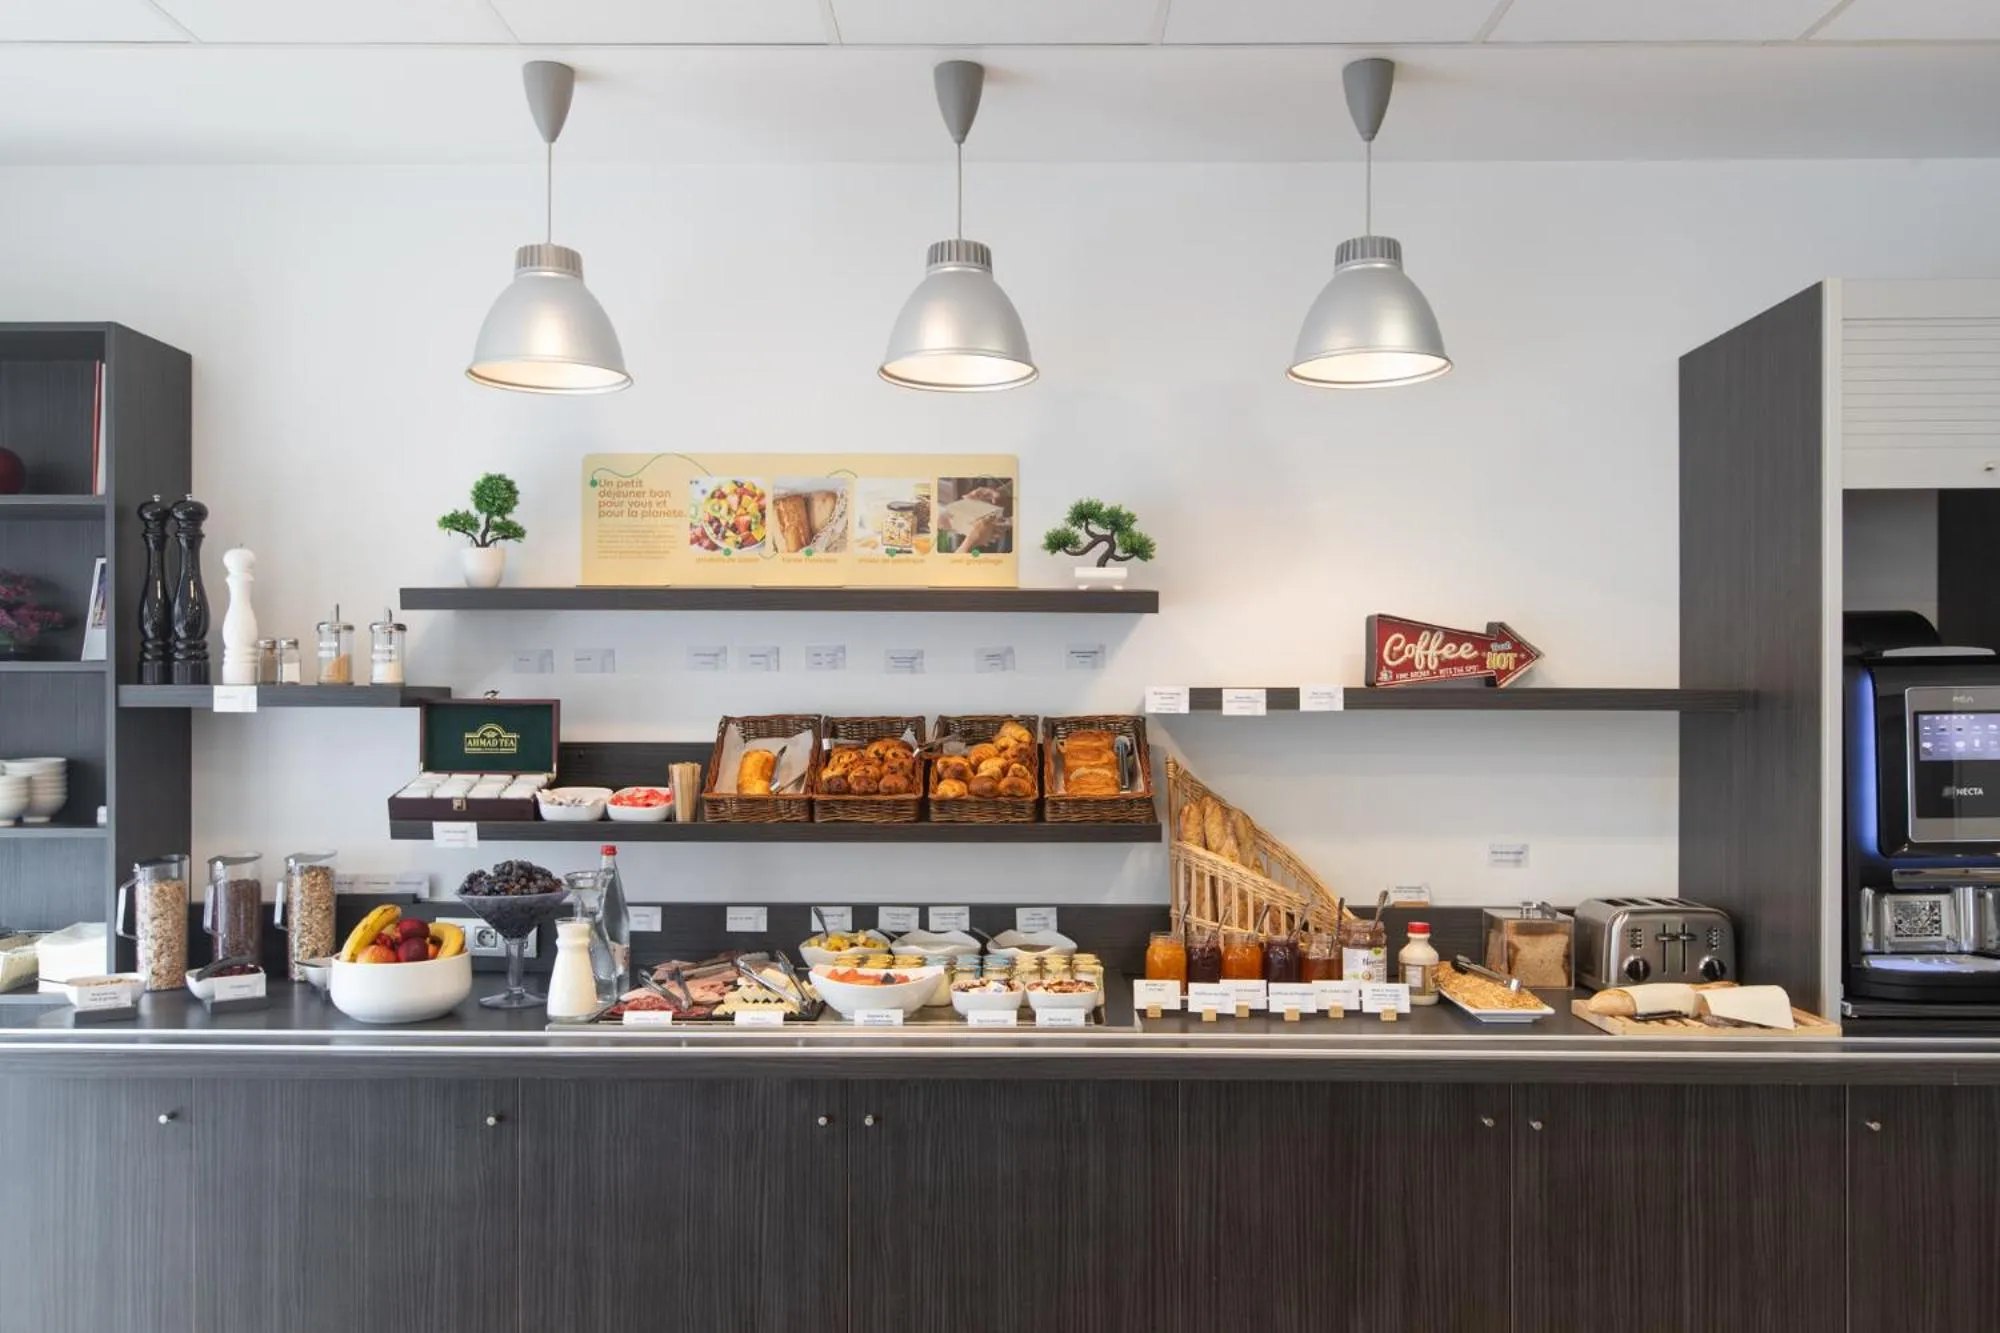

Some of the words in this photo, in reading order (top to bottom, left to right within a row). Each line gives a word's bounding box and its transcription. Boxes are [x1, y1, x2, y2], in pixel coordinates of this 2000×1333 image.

[599, 479, 613, 488] Un
[617, 479, 643, 490] petit
[649, 489, 672, 498] bon
[598, 499, 624, 509] pour
[627, 499, 653, 508] vous
[598, 509, 624, 519] pour
[627, 508, 638, 518] la
[1383, 630, 1479, 670] Coffee
[1486, 651, 1518, 671] HOT
[467, 738, 498, 747] AHMAD
[499, 738, 515, 747] TEA
[1955, 786, 1984, 797] NECTA
